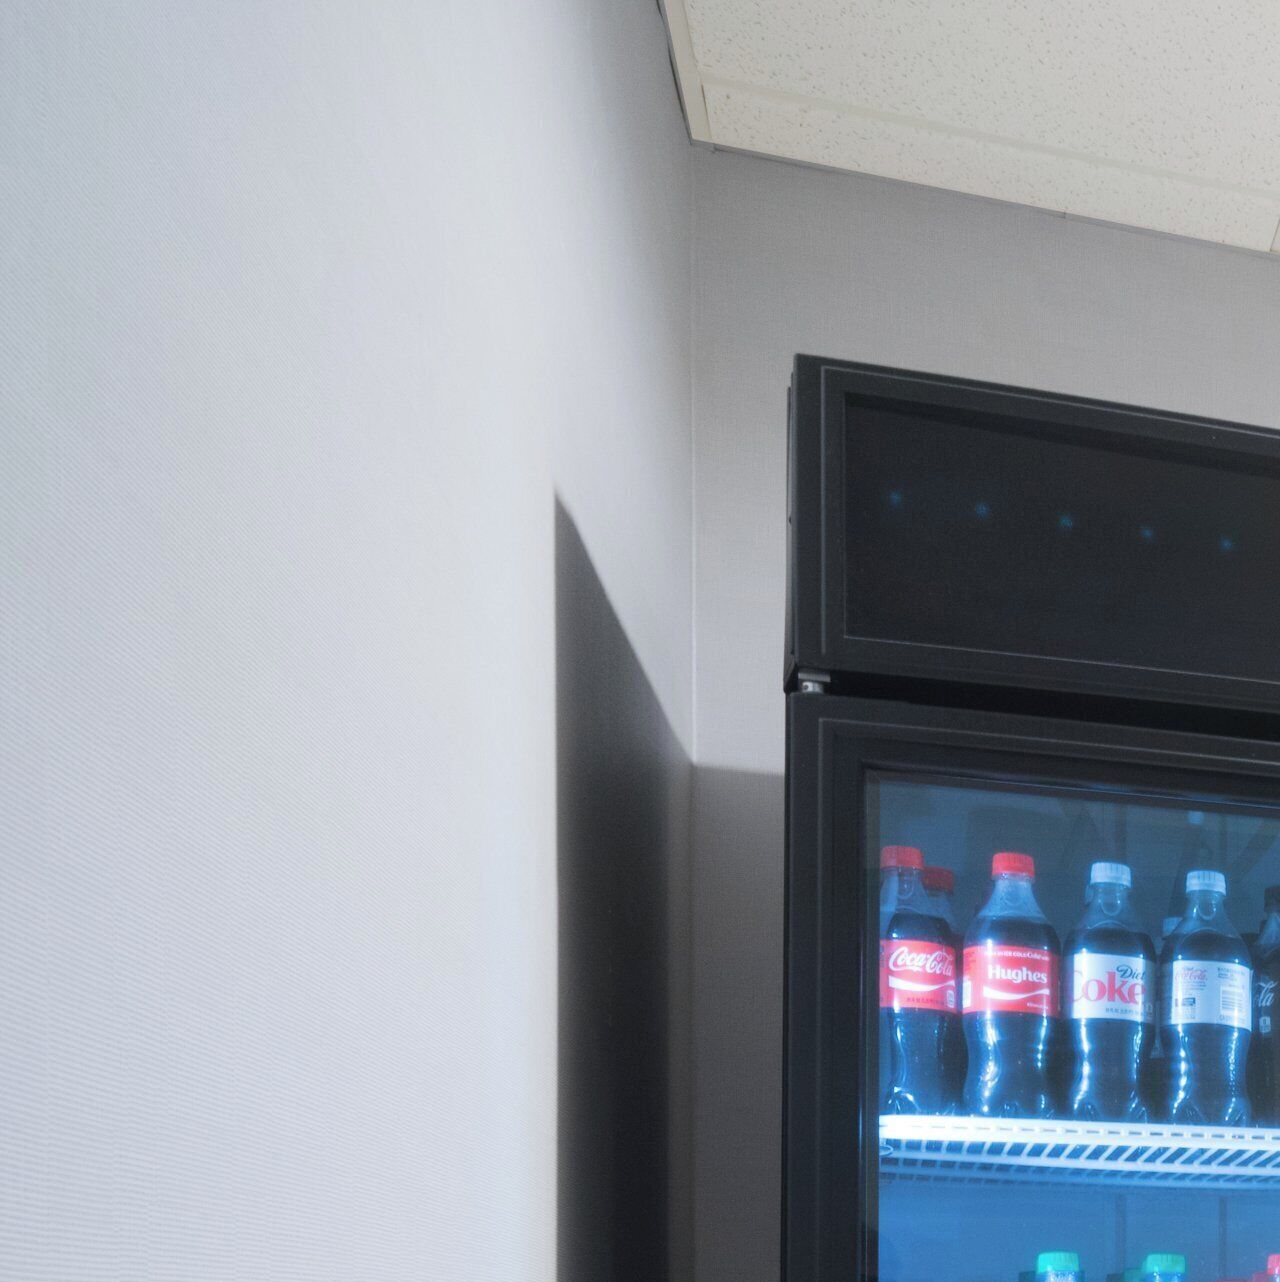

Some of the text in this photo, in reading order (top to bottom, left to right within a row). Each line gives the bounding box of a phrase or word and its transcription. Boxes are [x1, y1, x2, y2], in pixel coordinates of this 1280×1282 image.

[988, 965, 1047, 984] Hughes
[1116, 964, 1145, 981] Diet
[1074, 969, 1147, 1004] Coke
